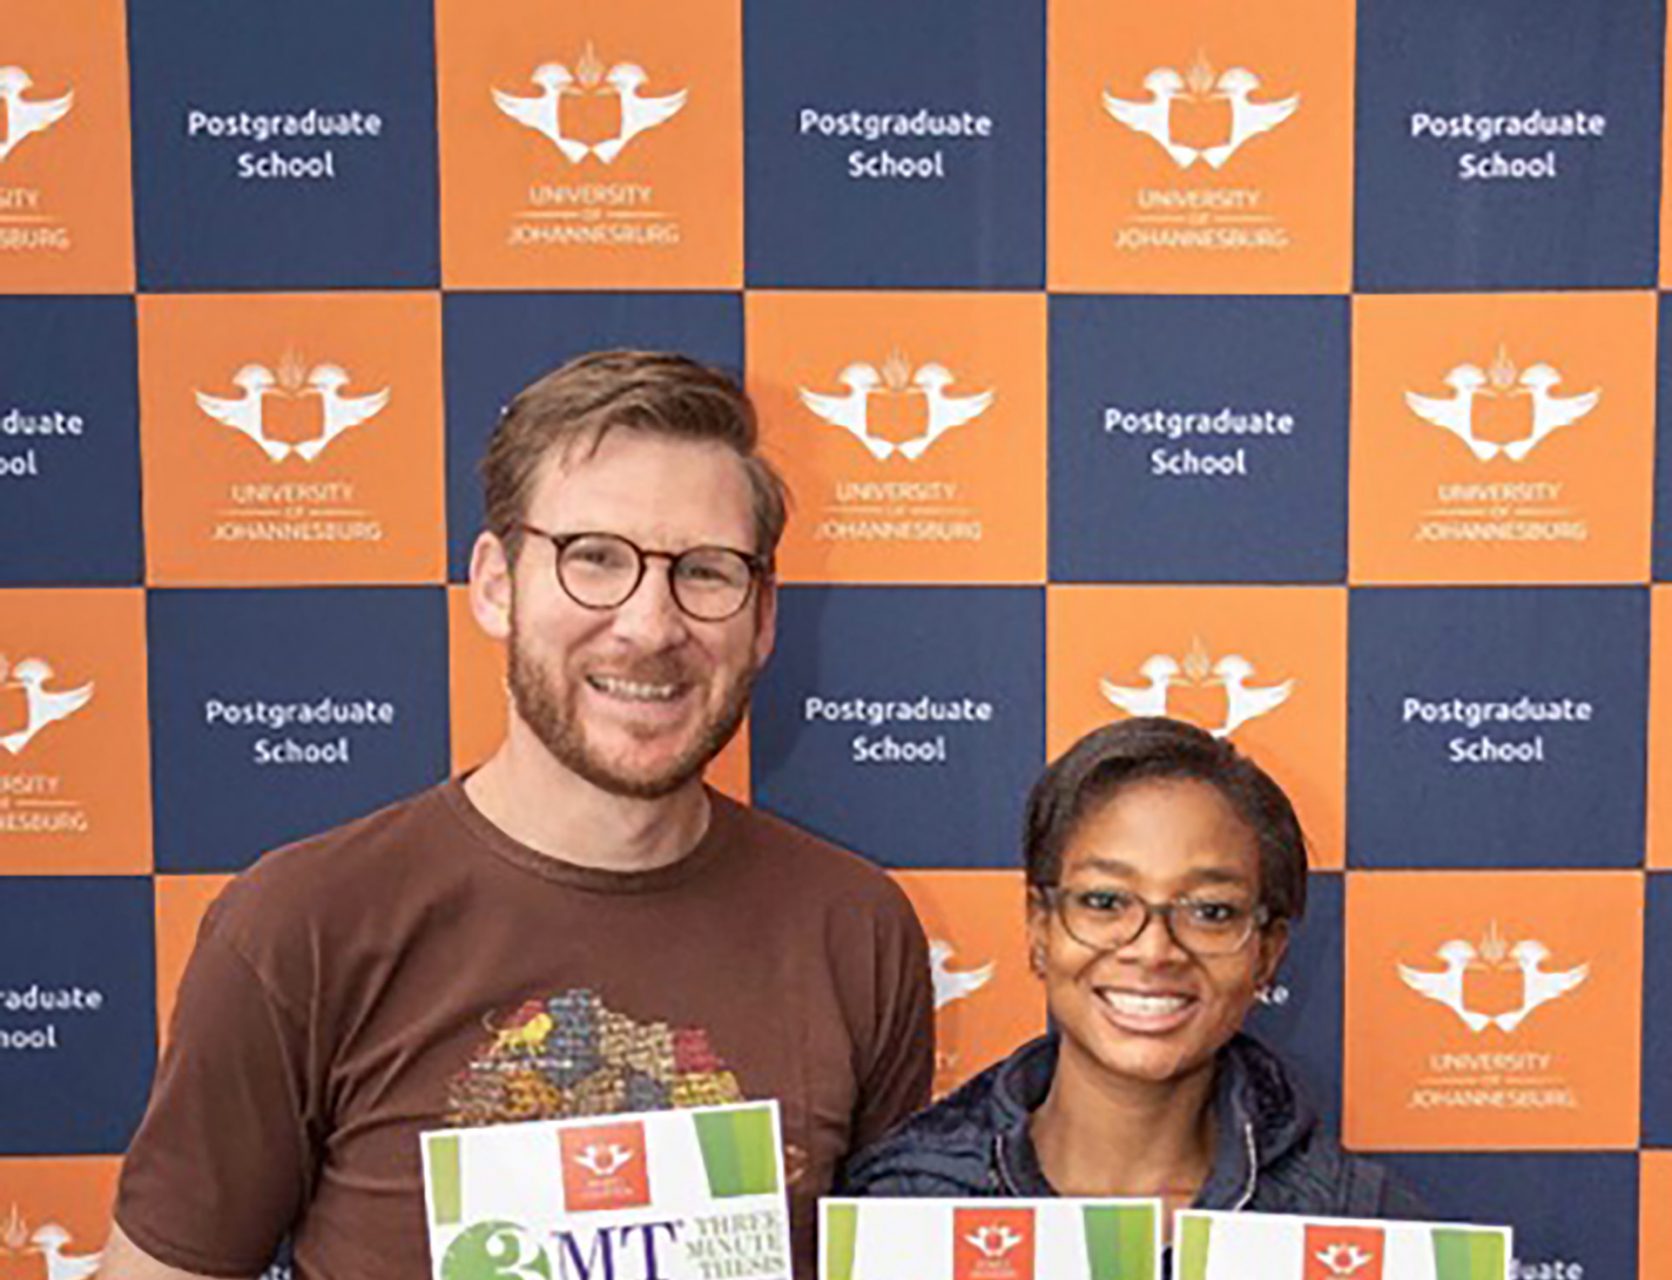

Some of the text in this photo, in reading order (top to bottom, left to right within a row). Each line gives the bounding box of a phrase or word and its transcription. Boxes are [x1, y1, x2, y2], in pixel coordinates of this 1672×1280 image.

[188, 110, 382, 140] Postgraduate
[800, 109, 992, 141] Postgraduate
[1410, 110, 1606, 141] Postgraduate
[237, 152, 335, 179] School
[848, 151, 944, 179] School
[1459, 151, 1556, 179] School
[1104, 408, 1295, 438] Postgraduate
[1151, 448, 1246, 476] School
[205, 699, 395, 728] Postgraduate
[805, 696, 993, 725] Postgraduate
[1402, 696, 1593, 725] Postgraduate
[253, 739, 349, 763] School
[852, 736, 947, 762] School
[1448, 736, 1544, 762] School
